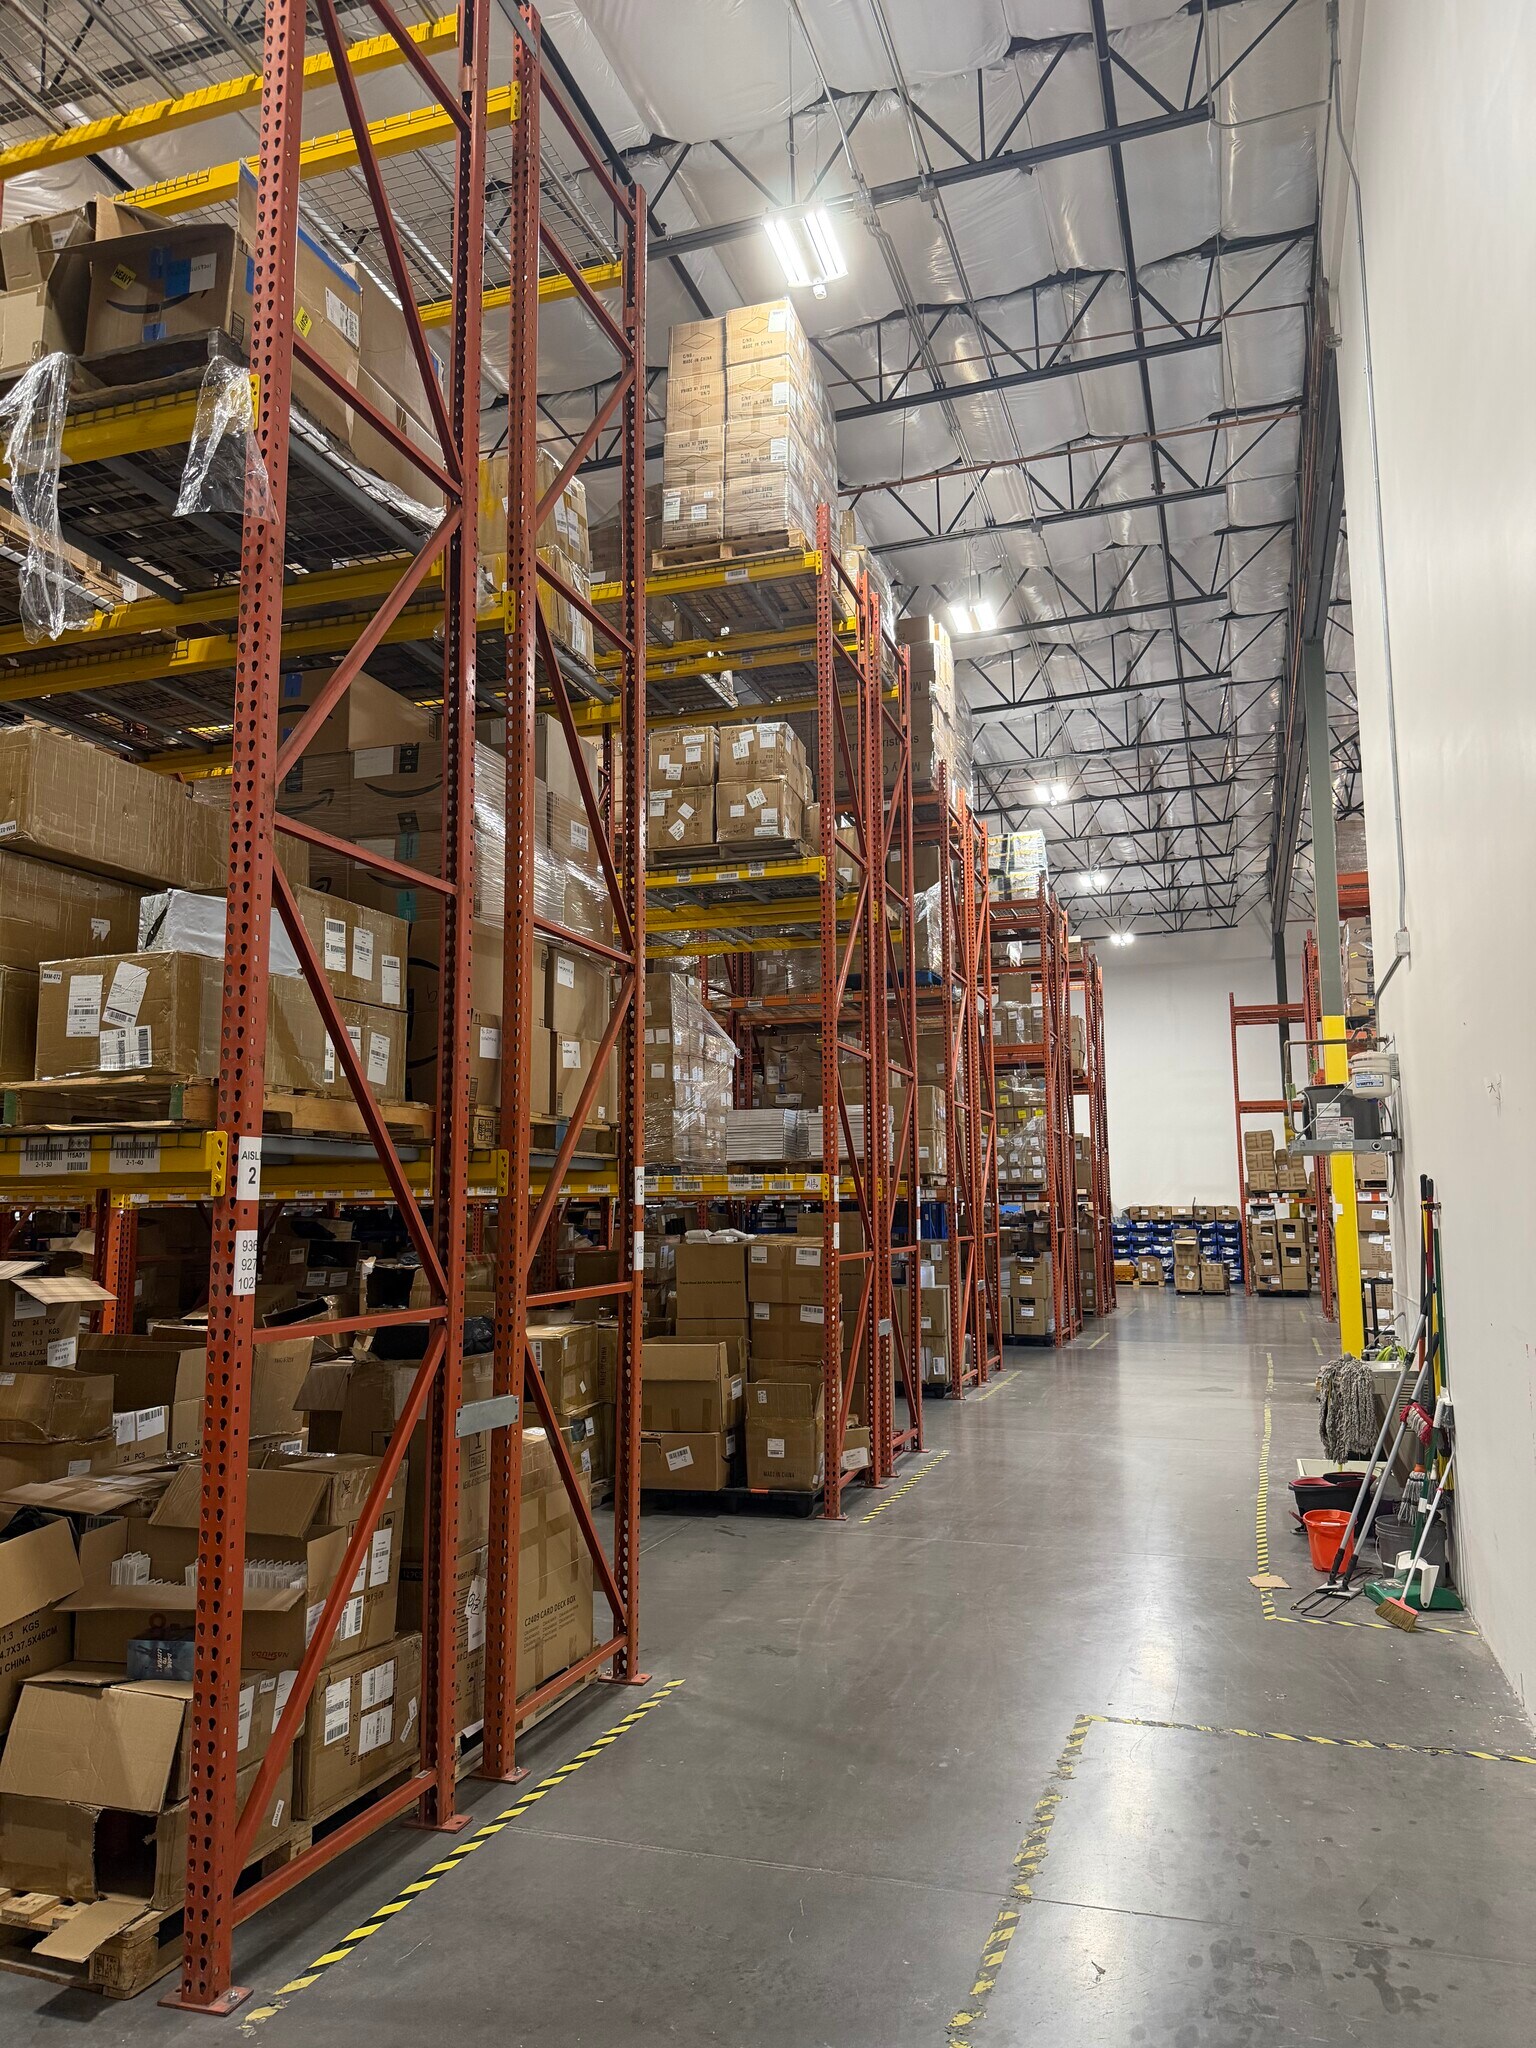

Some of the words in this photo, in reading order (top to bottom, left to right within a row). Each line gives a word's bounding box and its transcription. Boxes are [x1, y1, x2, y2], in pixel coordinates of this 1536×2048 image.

[114, 270, 132, 285] HEAVY
[248, 1166, 257, 1185] 2
[238, 1276, 256, 1290] 102
[48, 1327, 60, 1335] KGS
[123, 1455, 130, 1463] 24
[134, 1452, 146, 1460] PCS
[541, 1605, 553, 1619] CARD
[554, 1600, 566, 1612] DECK
[567, 1594, 576, 1606] BOX
[22, 1620, 40, 1634] KGS
[5, 1655, 31, 1673] CHINA
